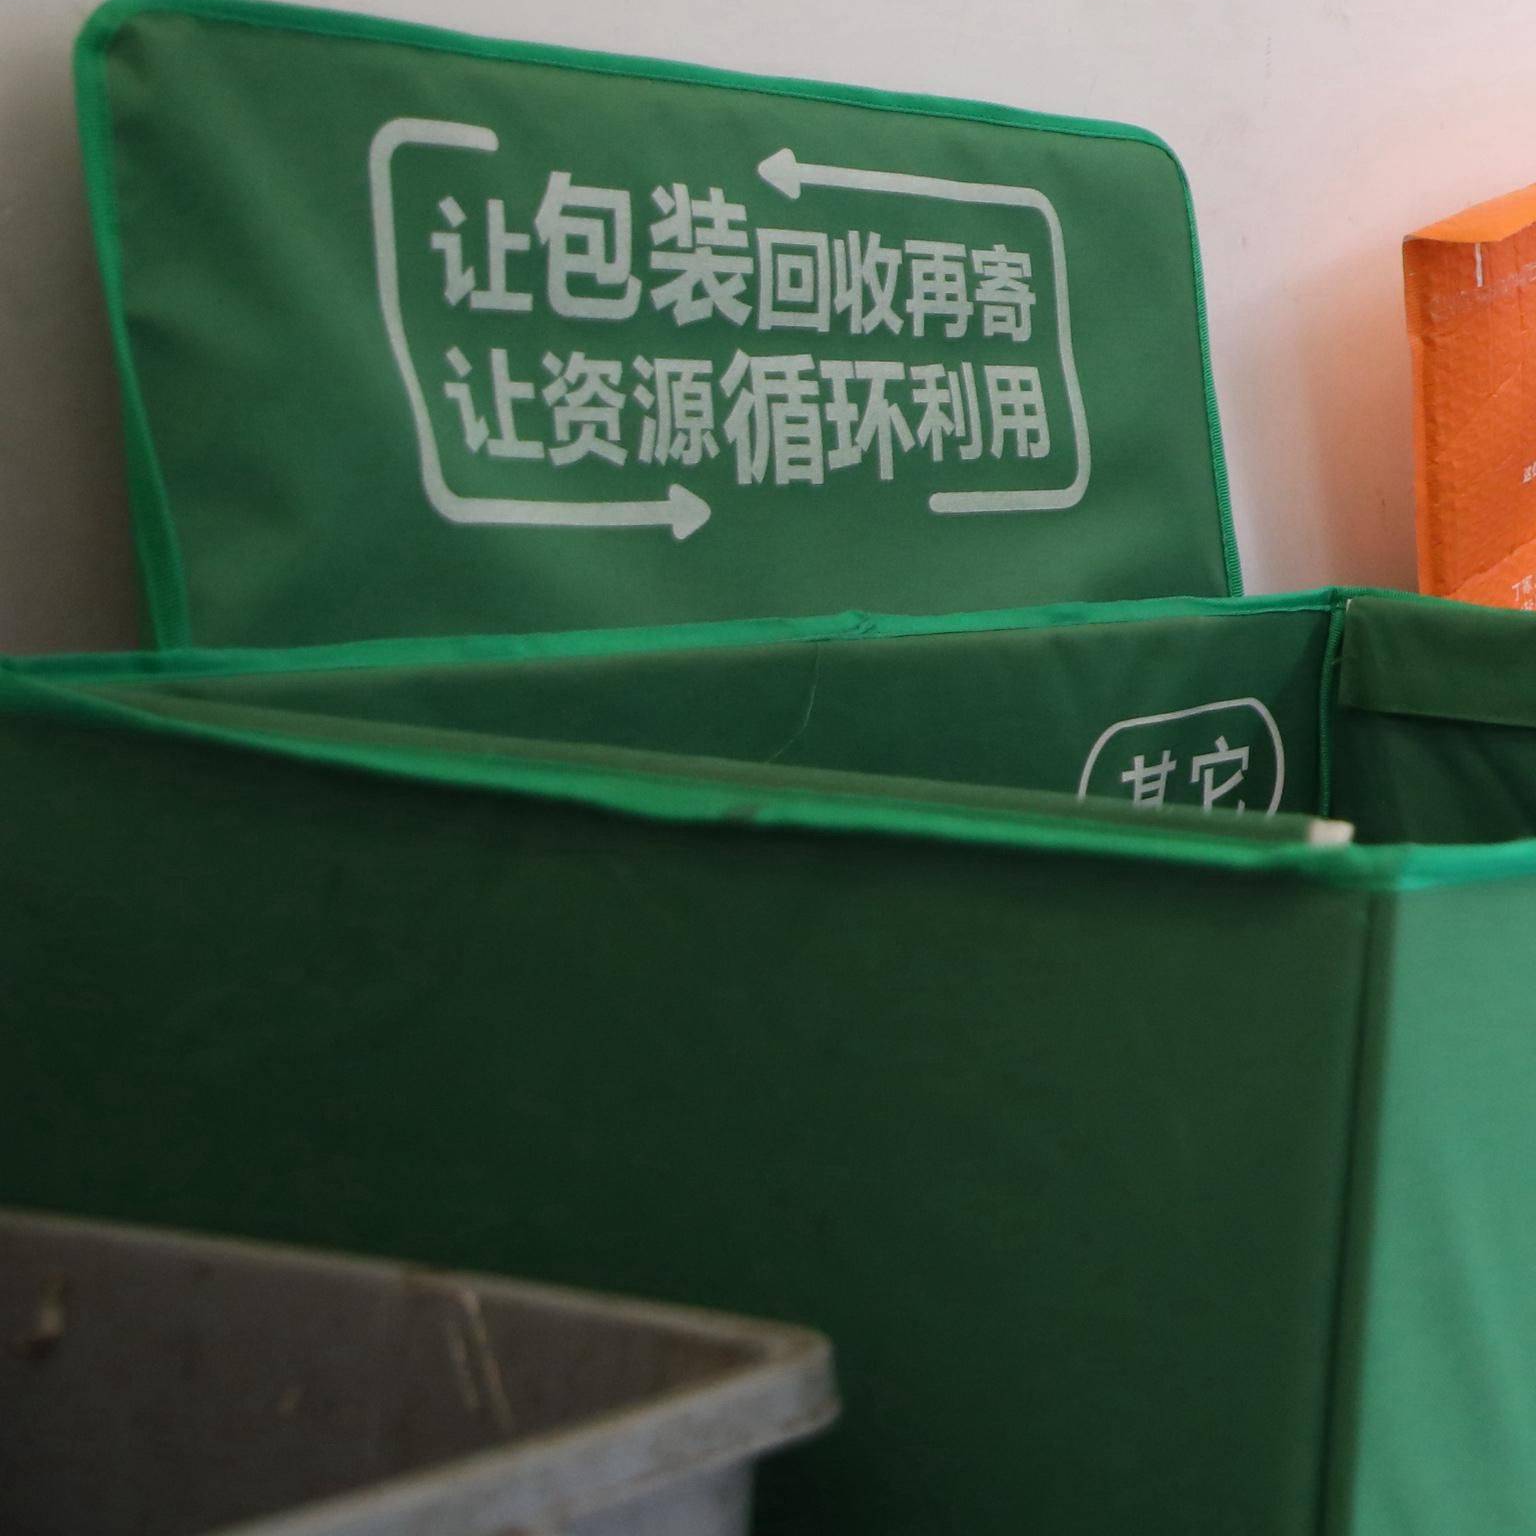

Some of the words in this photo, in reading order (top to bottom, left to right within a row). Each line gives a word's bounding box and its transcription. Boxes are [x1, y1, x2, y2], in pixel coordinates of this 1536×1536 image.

[430, 171, 1037, 342] 让包装回收再寄
[444, 346, 1052, 486] 让资源循环利用
